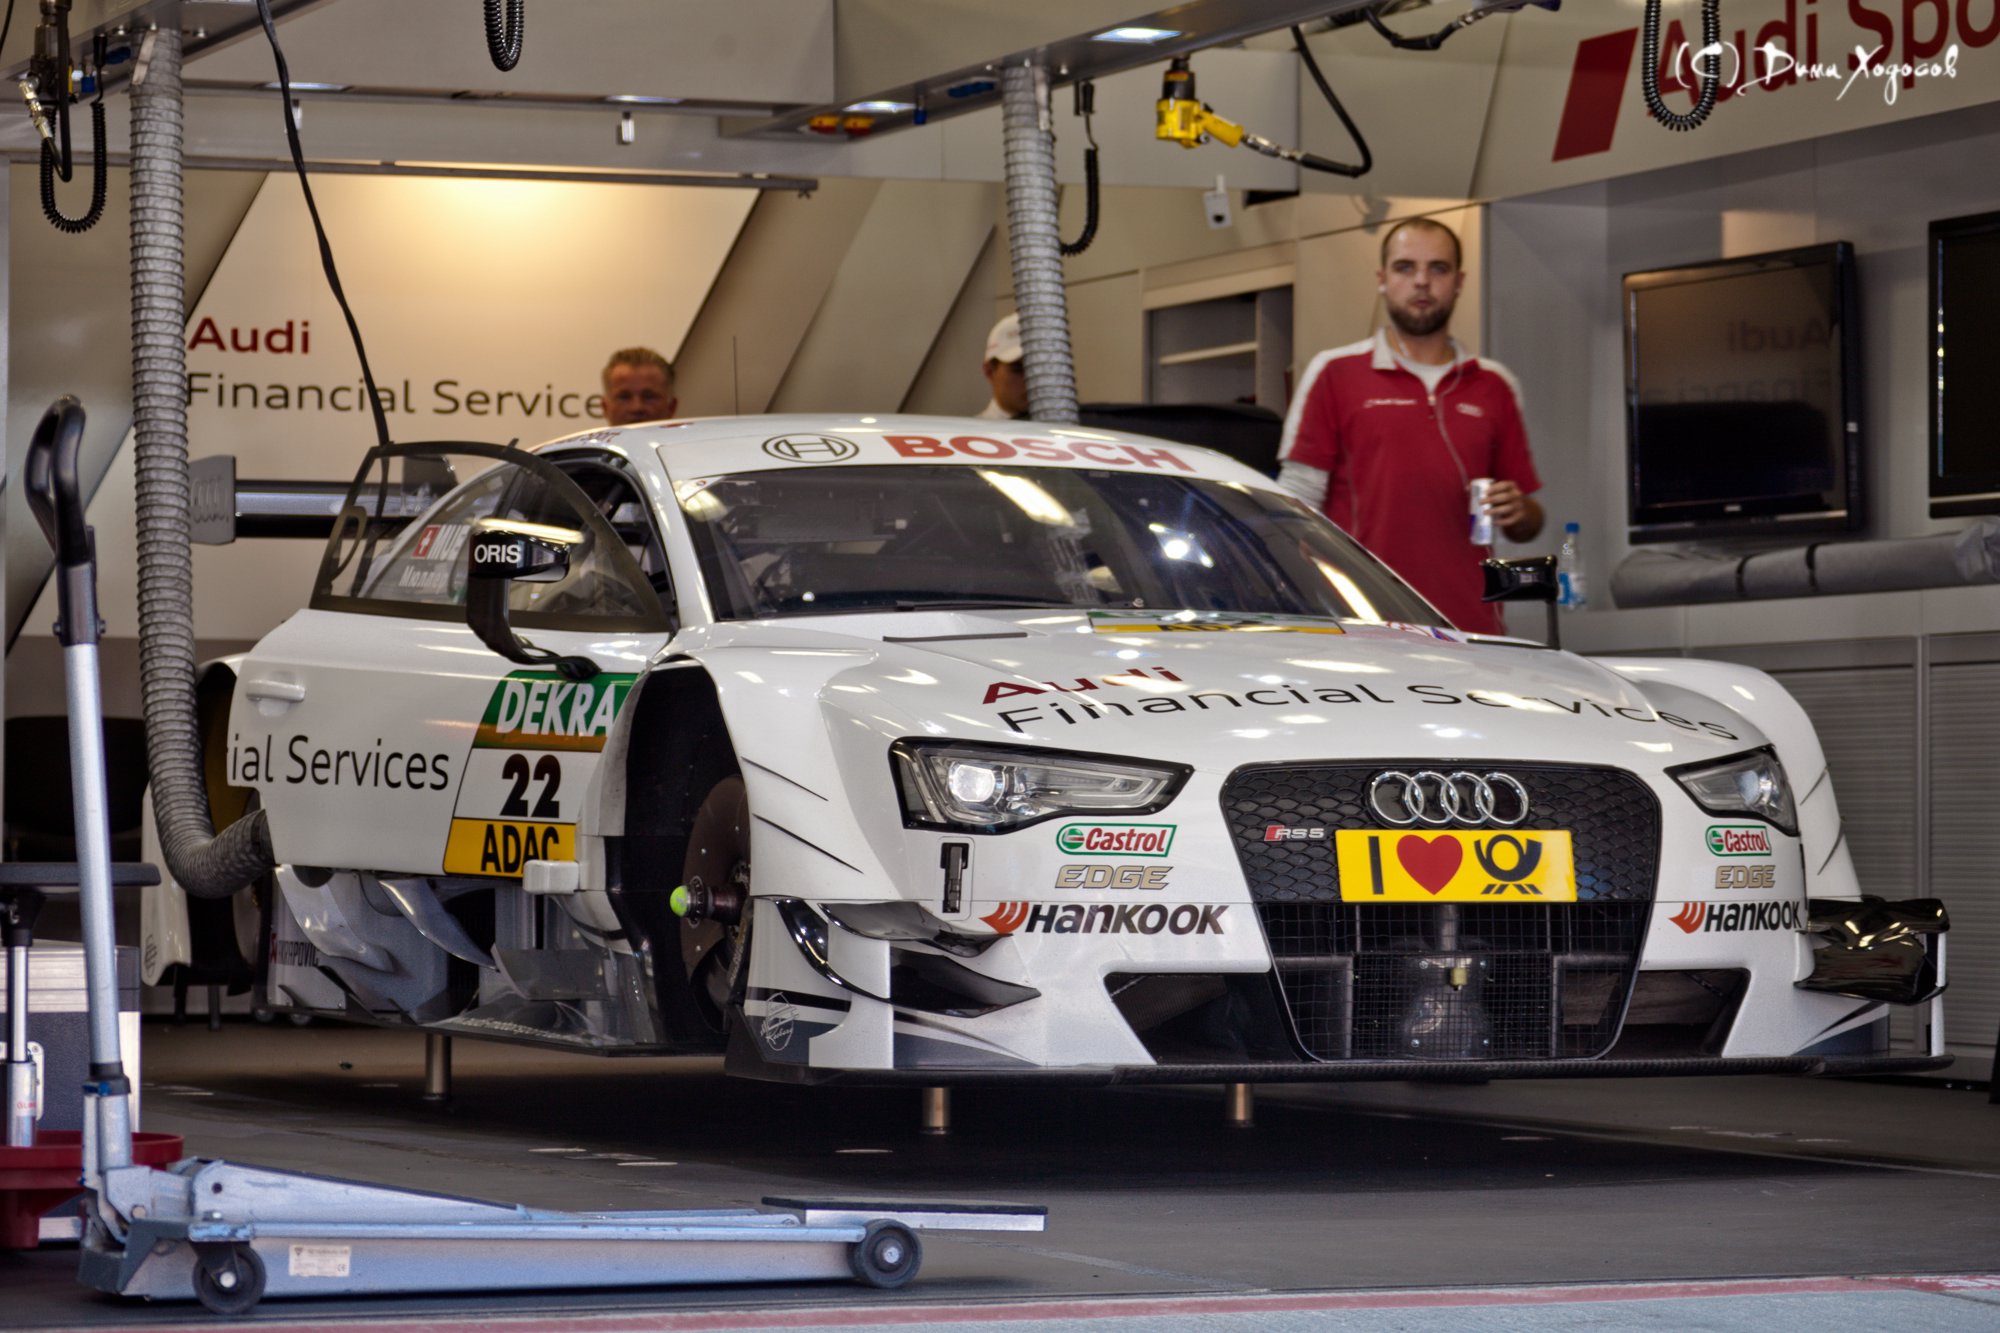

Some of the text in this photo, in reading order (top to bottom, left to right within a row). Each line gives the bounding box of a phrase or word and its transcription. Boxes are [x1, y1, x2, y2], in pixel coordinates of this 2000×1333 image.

[187, 317, 309, 354] Audi
[186, 372, 604, 419] Financial Service
[882, 435, 1197, 472] BOSCH
[474, 544, 522, 564] ORIS
[982, 667, 1183, 705] Audi
[496, 682, 616, 737] DEKRA
[998, 684, 1739, 741] Financial Services
[232, 733, 450, 790] ial Services
[499, 753, 561, 819] 22
[480, 823, 560, 874] ADAC
[1085, 827, 1167, 852] Castrol
[1275, 827, 1325, 840] RS5
[1724, 830, 1770, 853] Castrol
[1054, 864, 1174, 891] EDGE
[1367, 835, 1385, 896] I
[1714, 865, 1776, 889] EDGE
